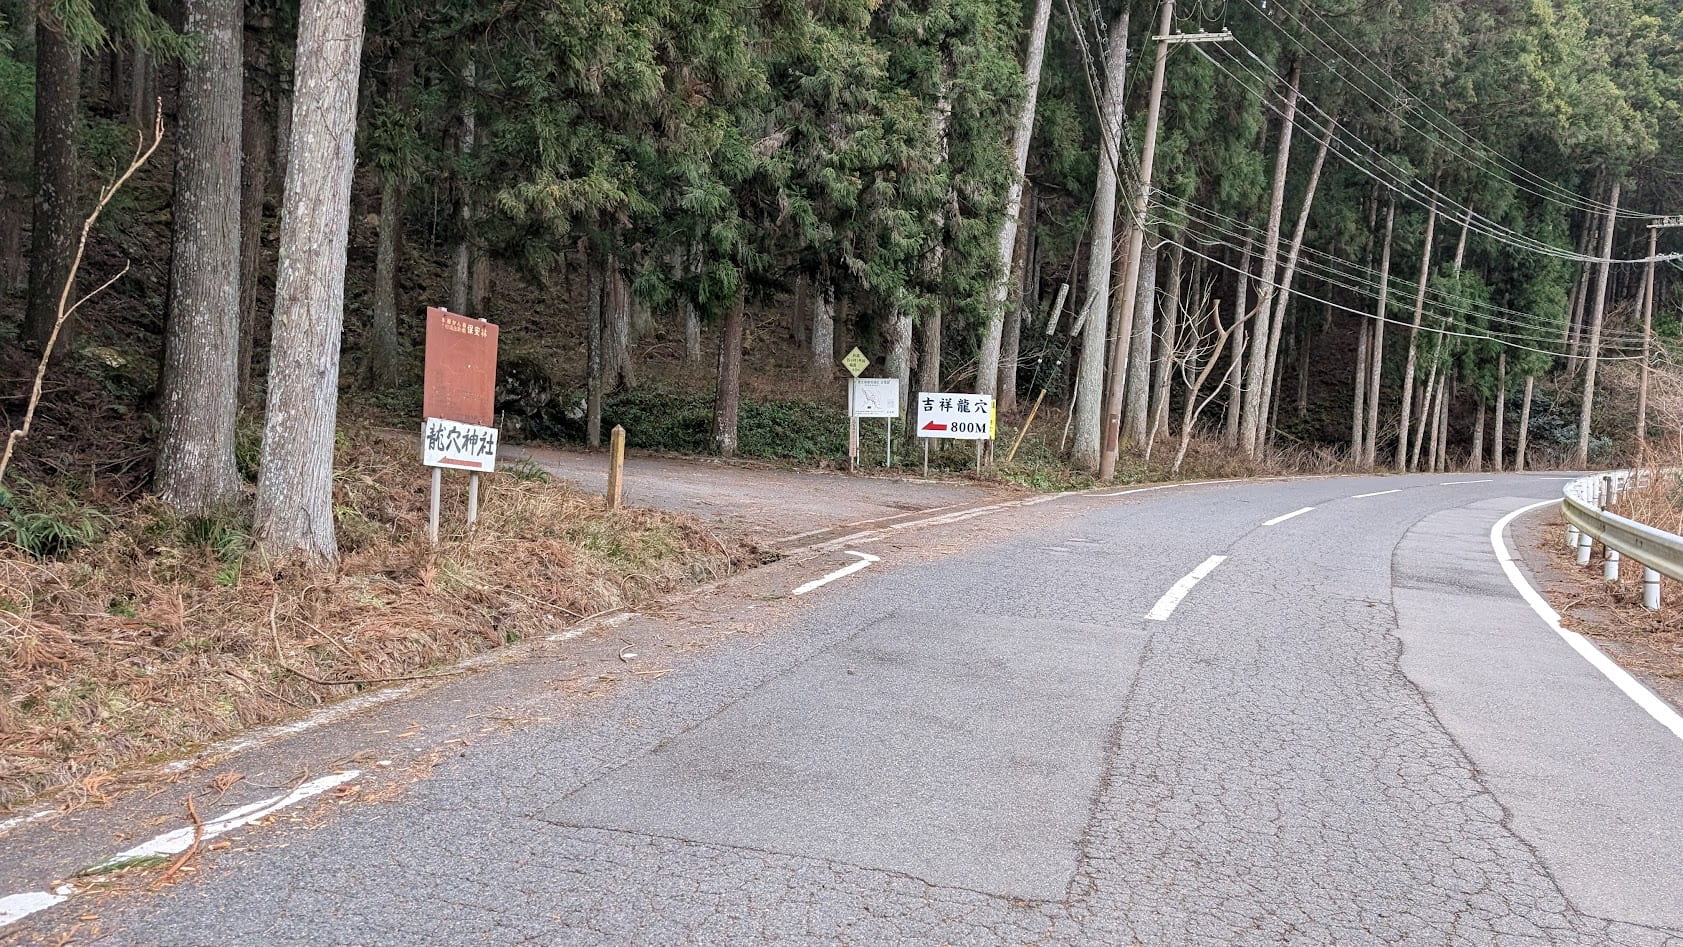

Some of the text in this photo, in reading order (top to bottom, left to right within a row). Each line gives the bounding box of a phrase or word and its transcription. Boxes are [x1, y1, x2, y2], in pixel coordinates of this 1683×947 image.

[467, 324, 487, 337] 保安林
[922, 397, 988, 413] 吉祥龍穴
[951, 422, 987, 433] 800M
